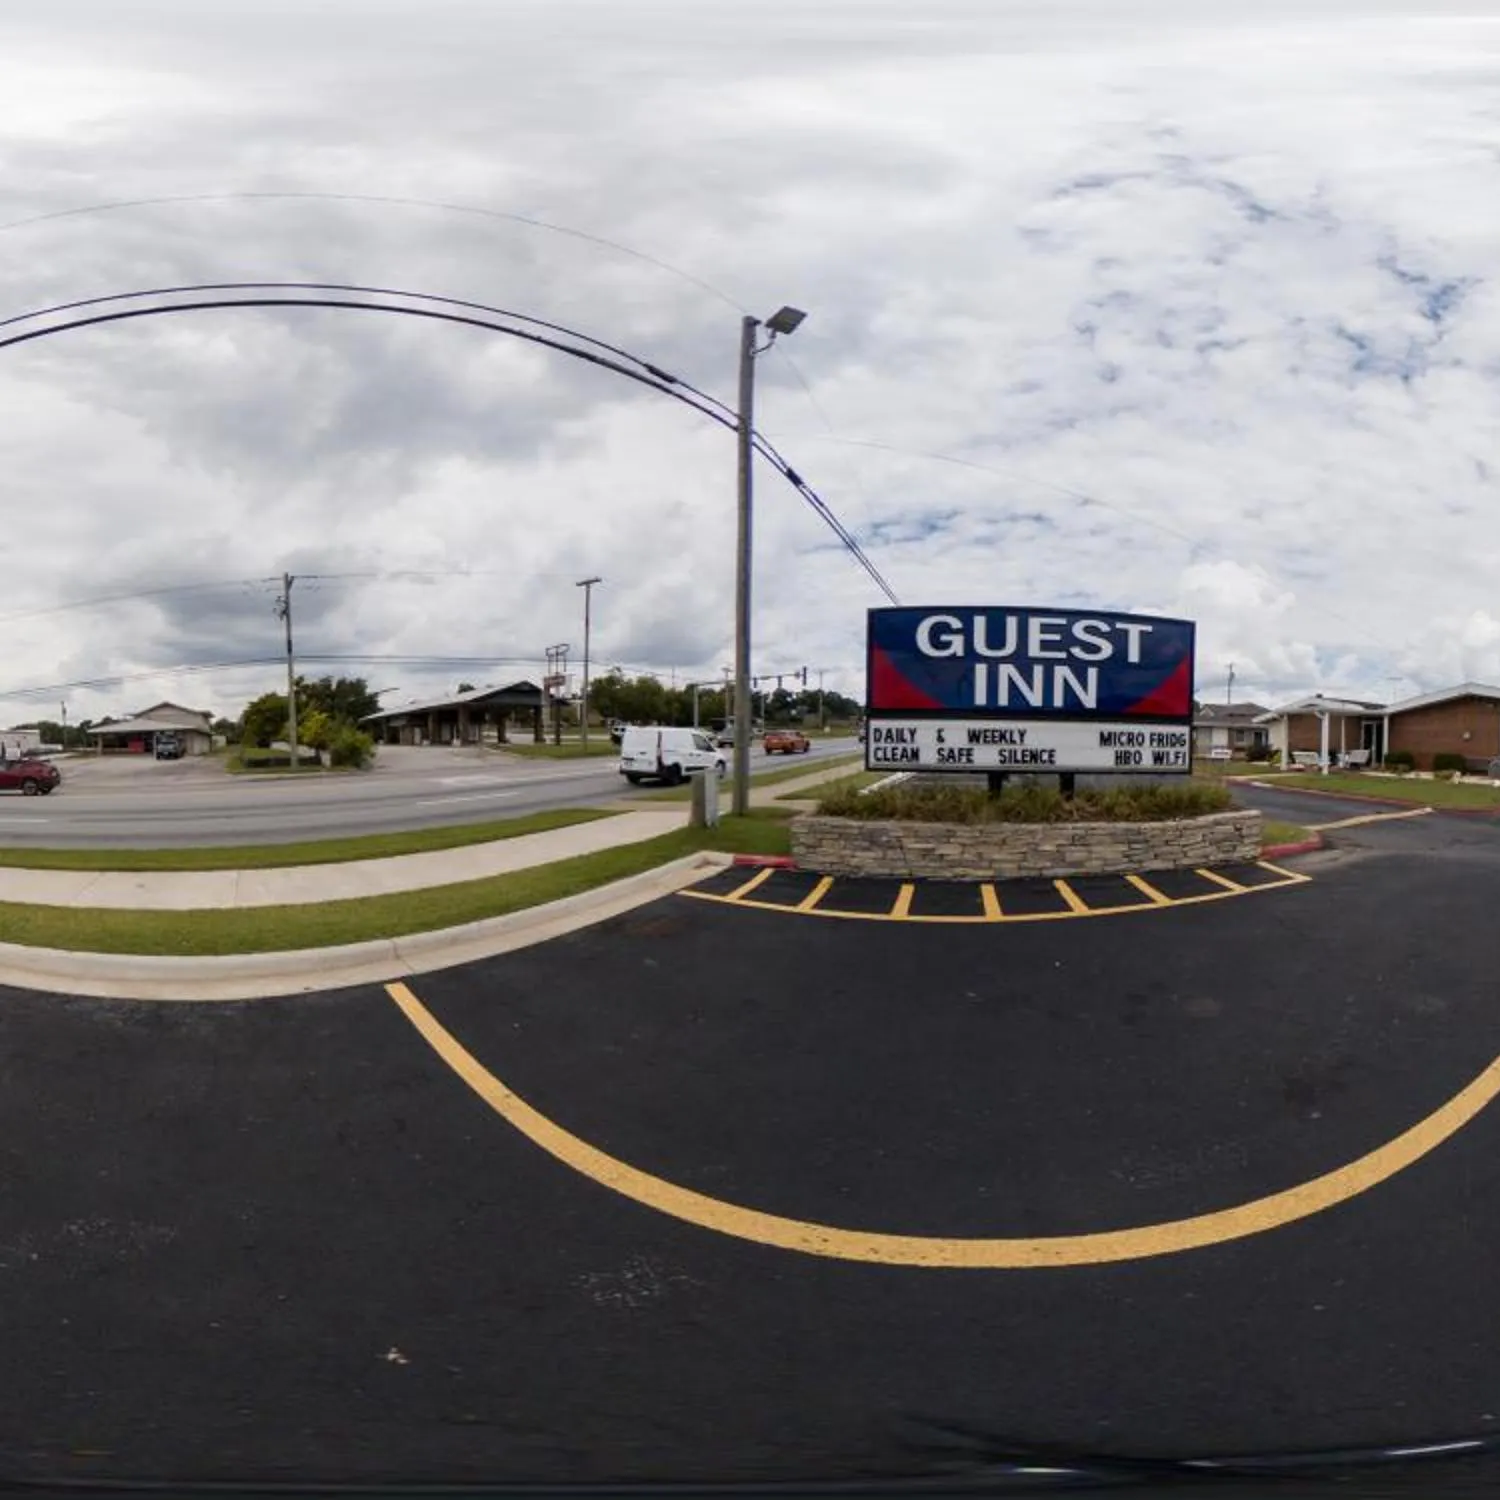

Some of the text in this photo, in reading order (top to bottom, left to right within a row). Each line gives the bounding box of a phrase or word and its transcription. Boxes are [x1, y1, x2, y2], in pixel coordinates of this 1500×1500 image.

[915, 615, 1153, 663] GUEST
[973, 663, 1099, 709] INN
[873, 727, 917, 744] DAILY
[936, 728, 946, 744] &
[967, 728, 1027, 745] WEEKLY
[1099, 731, 1145, 748] MICRO
[873, 746, 920, 763] CLEAN
[936, 747, 975, 764] SAFE
[998, 748, 1056, 765] SILENCE
[1114, 750, 1143, 767] HBO
